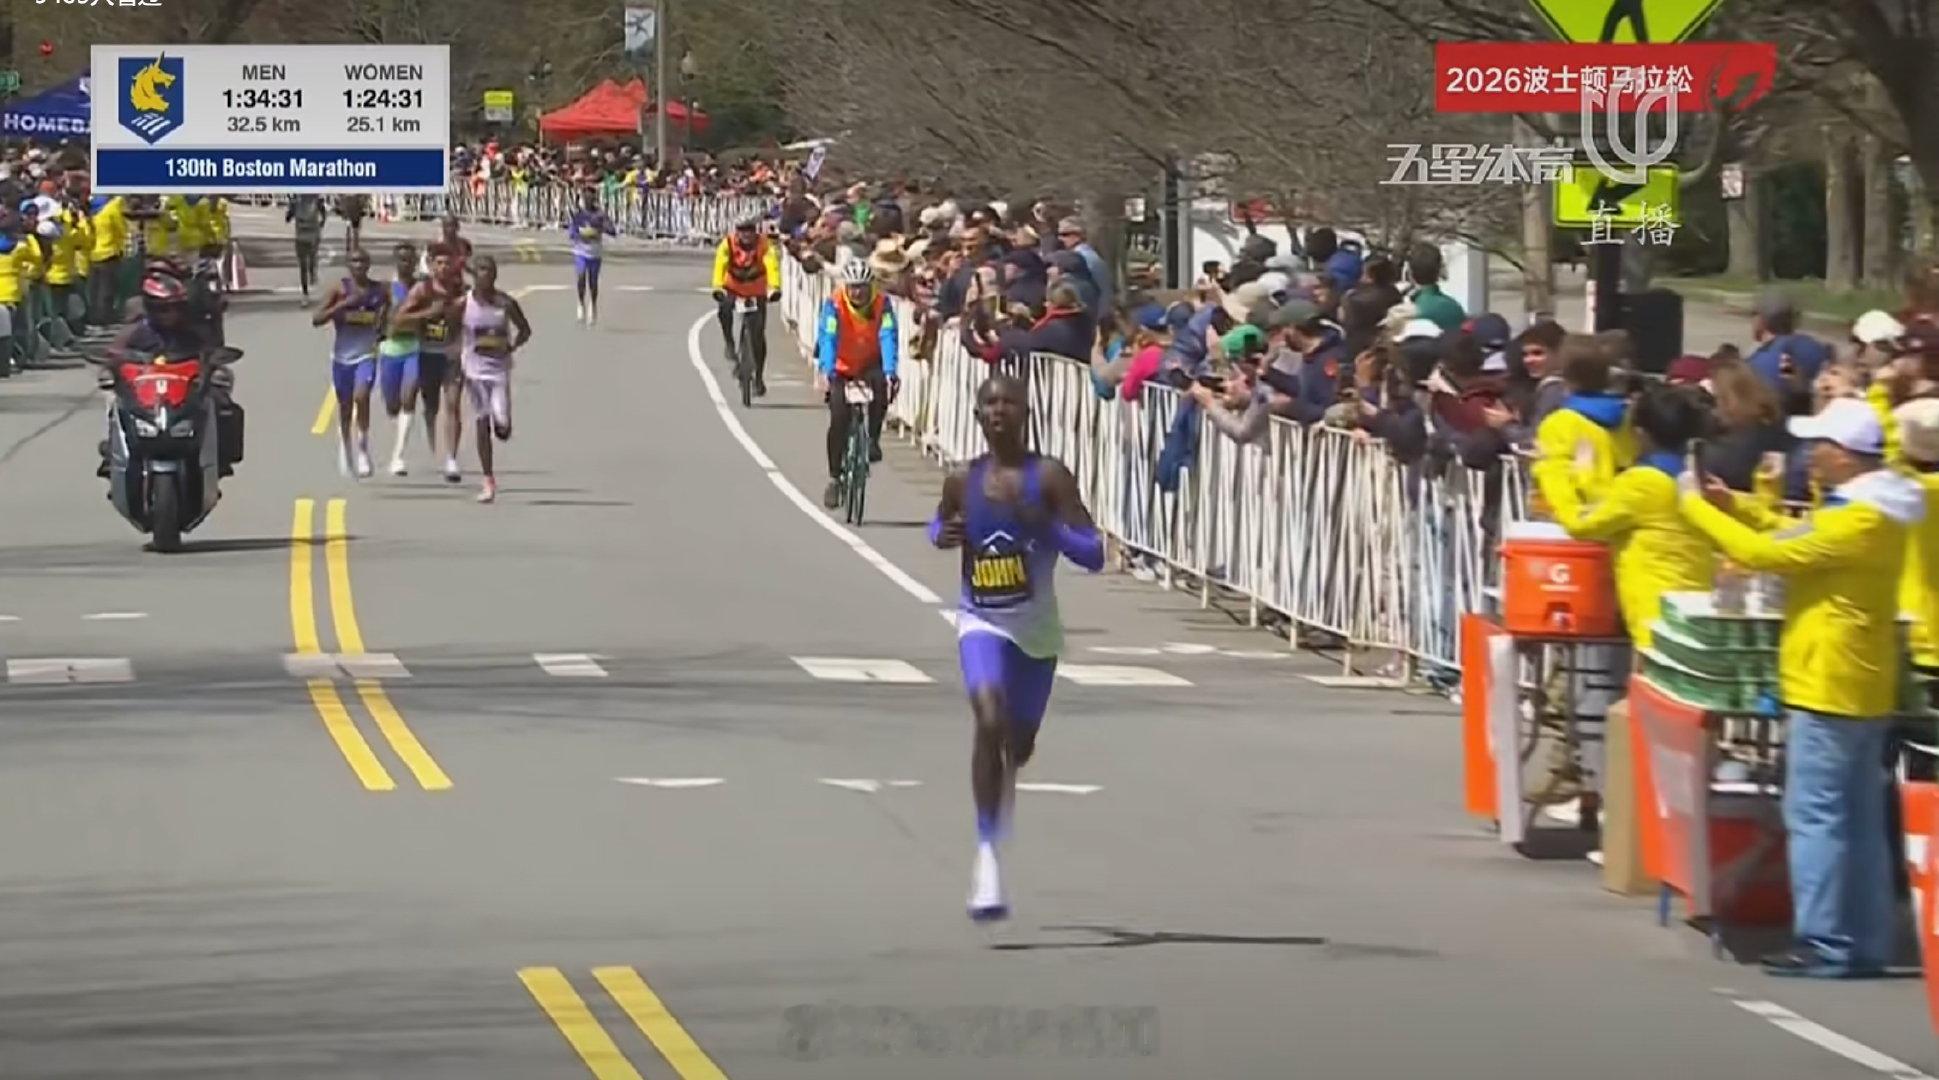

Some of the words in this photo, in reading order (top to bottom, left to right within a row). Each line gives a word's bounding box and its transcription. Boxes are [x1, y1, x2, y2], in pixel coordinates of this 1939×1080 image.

[4, 113, 91, 133] HOMEB
[972, 555, 1026, 588] JOHN
[1550, 563, 1570, 584] G
